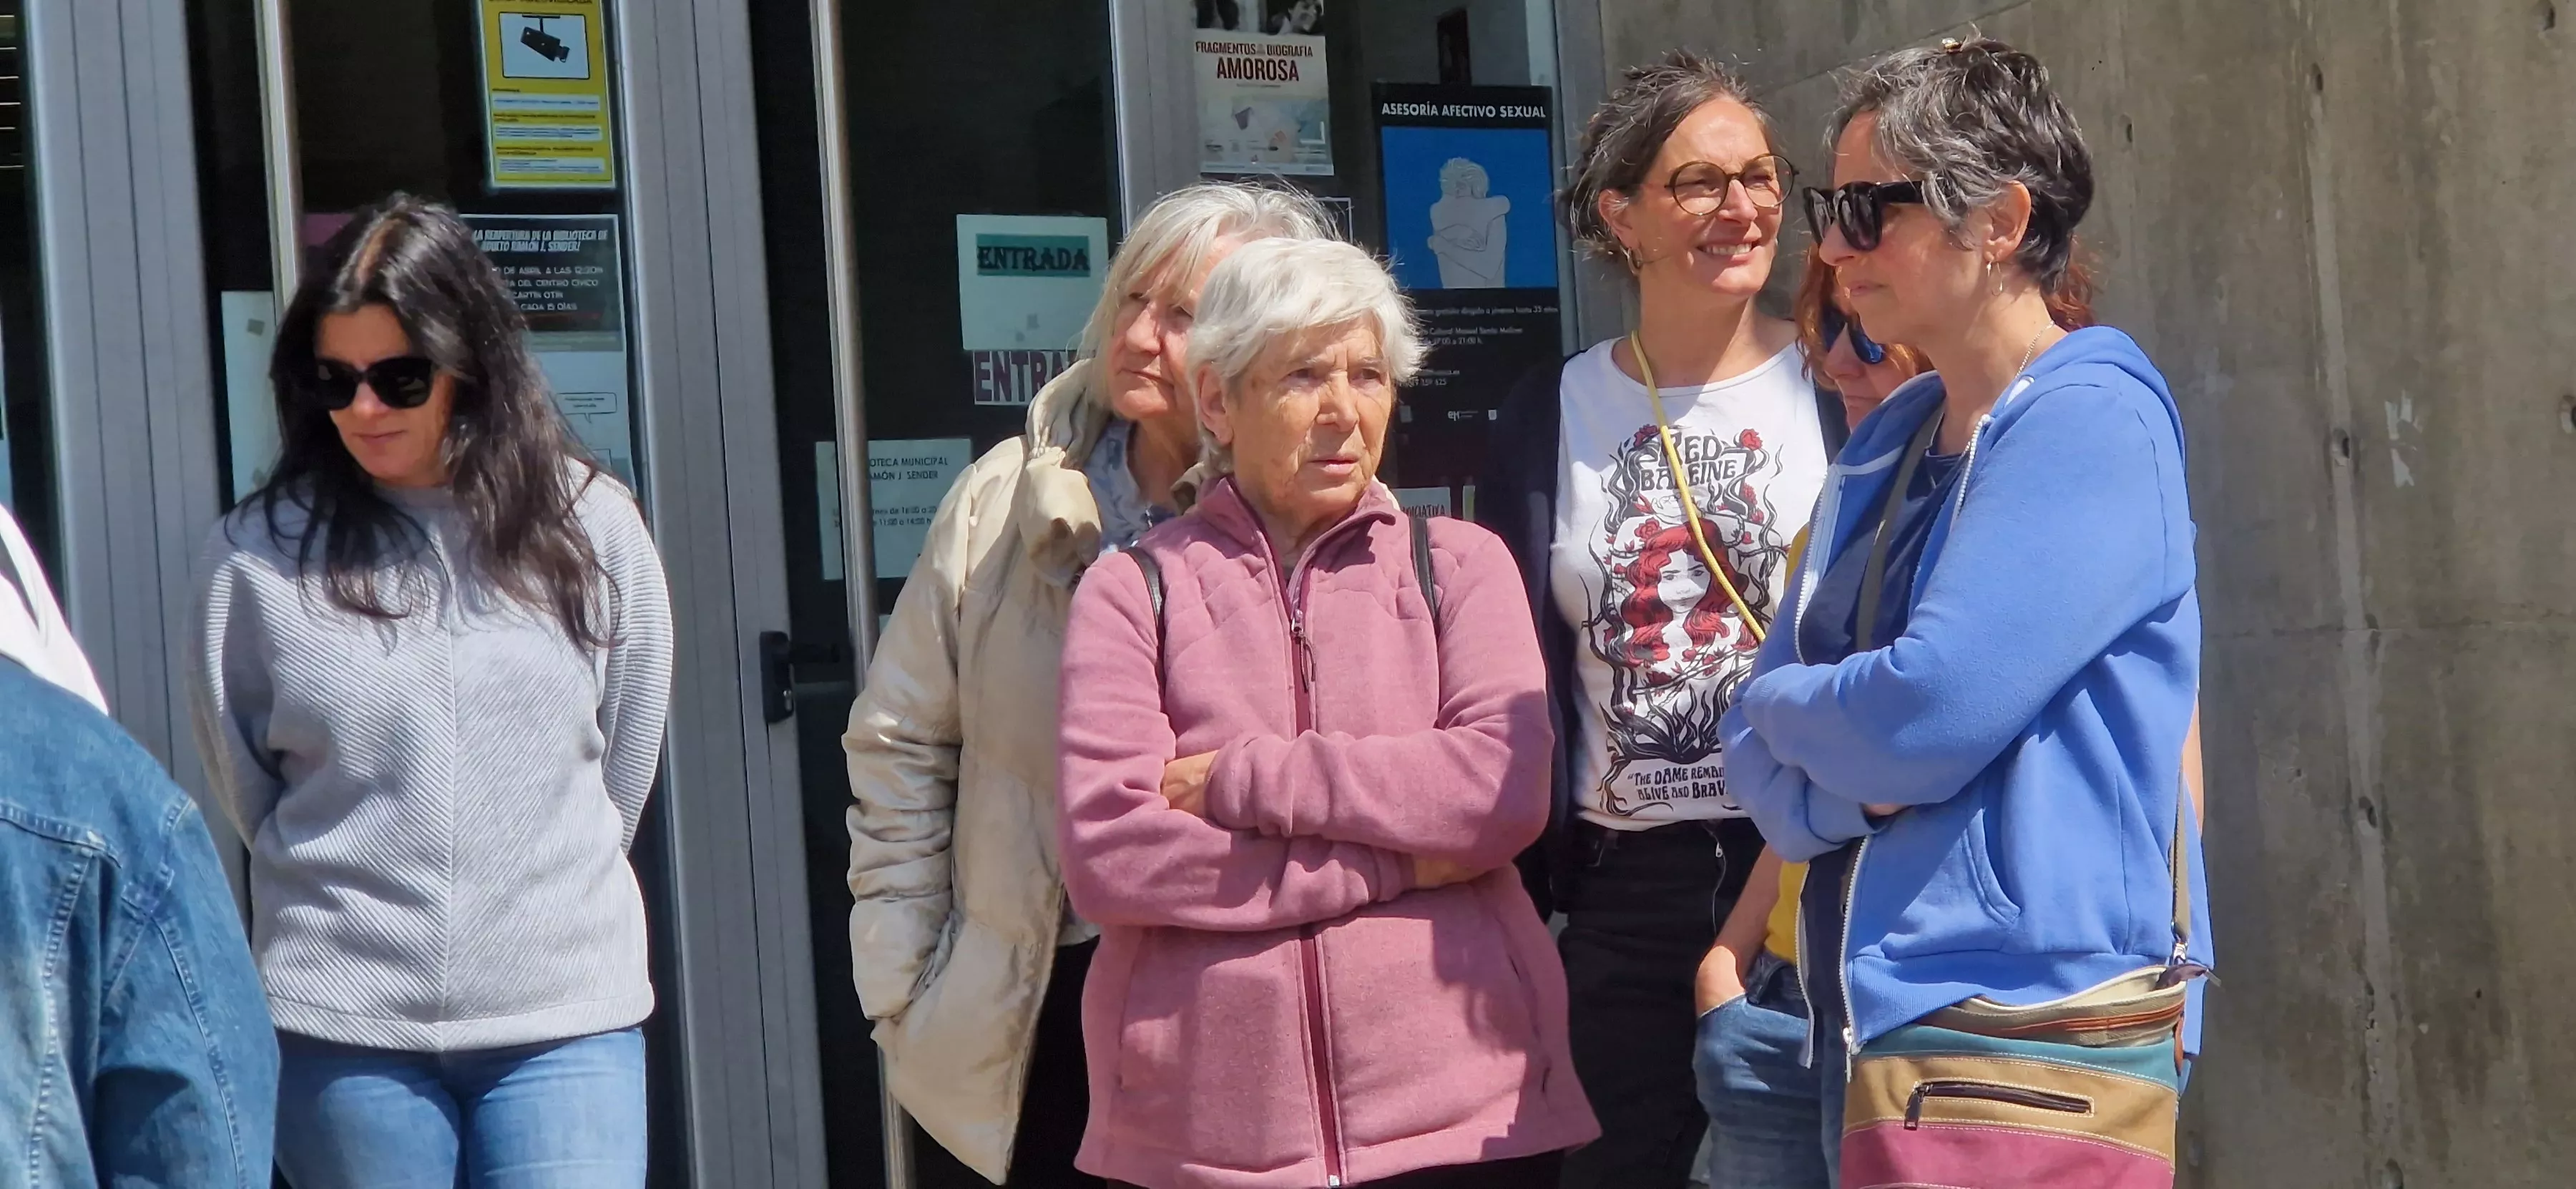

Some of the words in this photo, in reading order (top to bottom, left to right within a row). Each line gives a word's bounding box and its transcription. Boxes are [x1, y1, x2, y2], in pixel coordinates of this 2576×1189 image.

[1195, 41, 1256, 55] FRAGMENTOS
[1217, 57, 1300, 82] AMOROSA
[1381, 101, 1439, 116] ASESORÍA
[1441, 105, 1496, 117] AFECTIVO
[1499, 106, 1546, 118] SEXUAL
[976, 246, 1091, 272] ENTRADA
[869, 458, 899, 467] OTECA
[901, 456, 949, 466] MUNICIPAL
[907, 470, 939, 479] SENDER
[1640, 459, 1738, 491] BAEINE
[1654, 766, 1688, 786] DAME
[1637, 786, 1669, 801] ALIVE
[1692, 779, 1728, 799] BRAV
